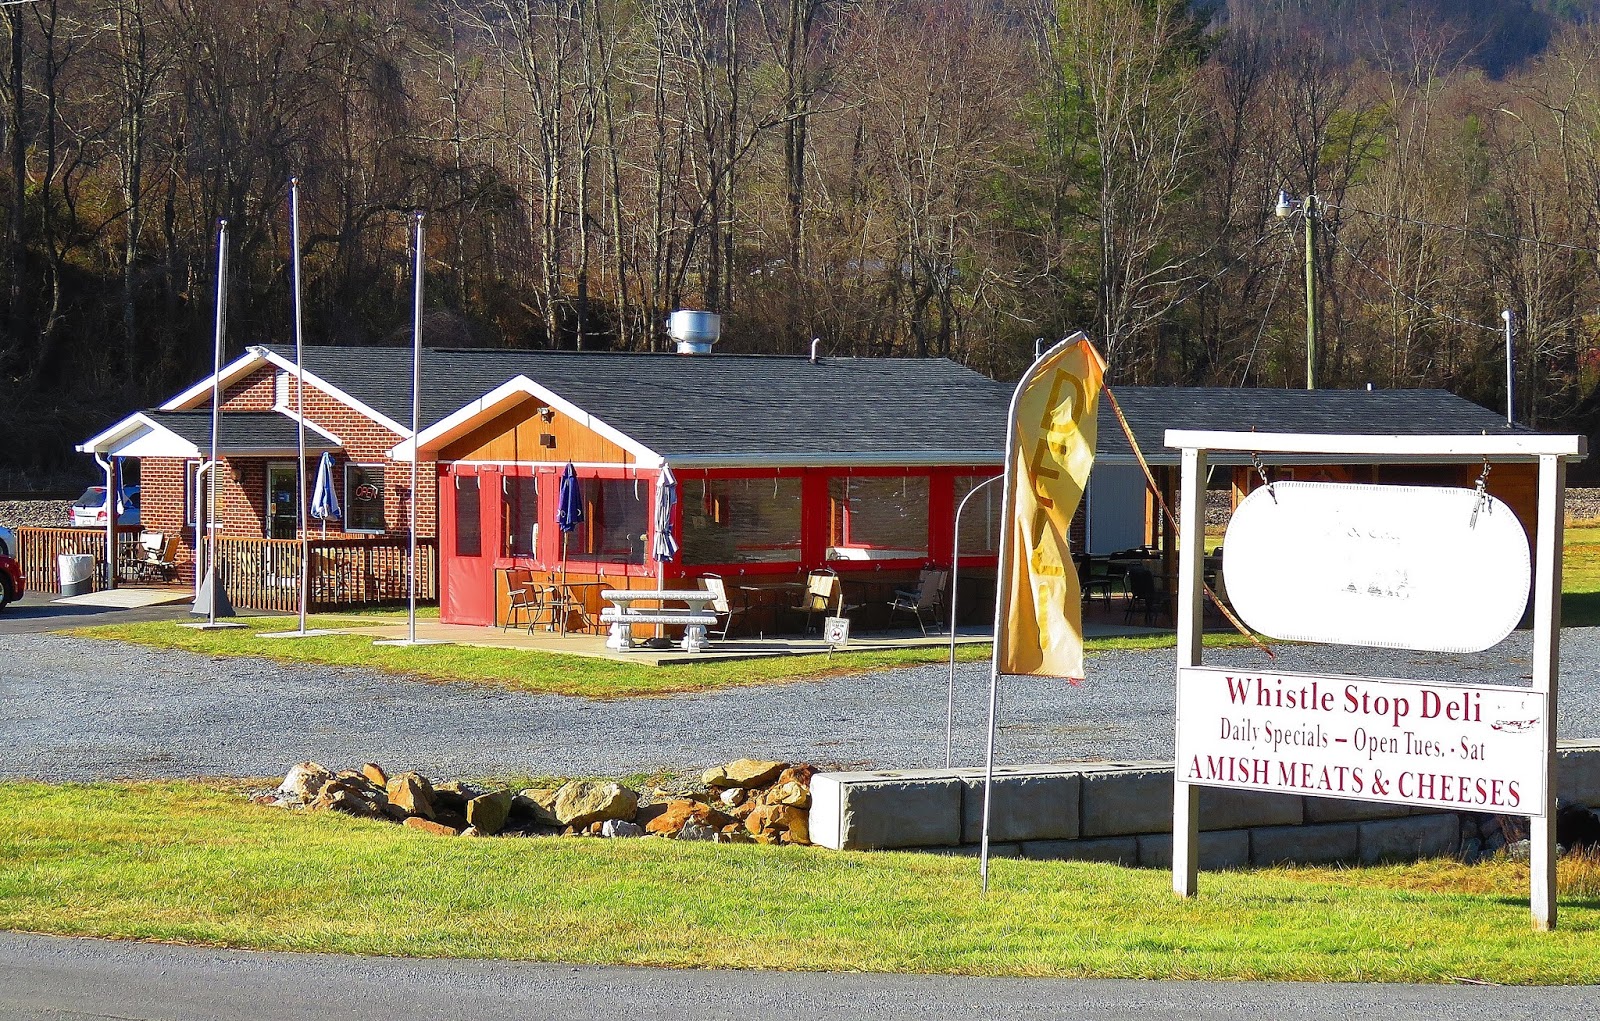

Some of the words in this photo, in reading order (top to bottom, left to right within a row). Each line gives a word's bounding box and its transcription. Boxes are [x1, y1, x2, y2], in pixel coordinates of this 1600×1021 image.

[1225, 676, 1334, 712] Whistle
[1344, 684, 1410, 728] Stop
[1420, 689, 1482, 722] Deli
[1220, 717, 1260, 751] Daily
[1264, 720, 1329, 753] Specials
[1354, 727, 1399, 761] Open
[1404, 731, 1445, 758] Tues.
[1460, 735, 1485, 761] Sat
[1187, 753, 1270, 784] AMISH
[1277, 760, 1364, 794] MEATS
[1371, 768, 1390, 796] &
[1398, 771, 1521, 808] CHEESES
